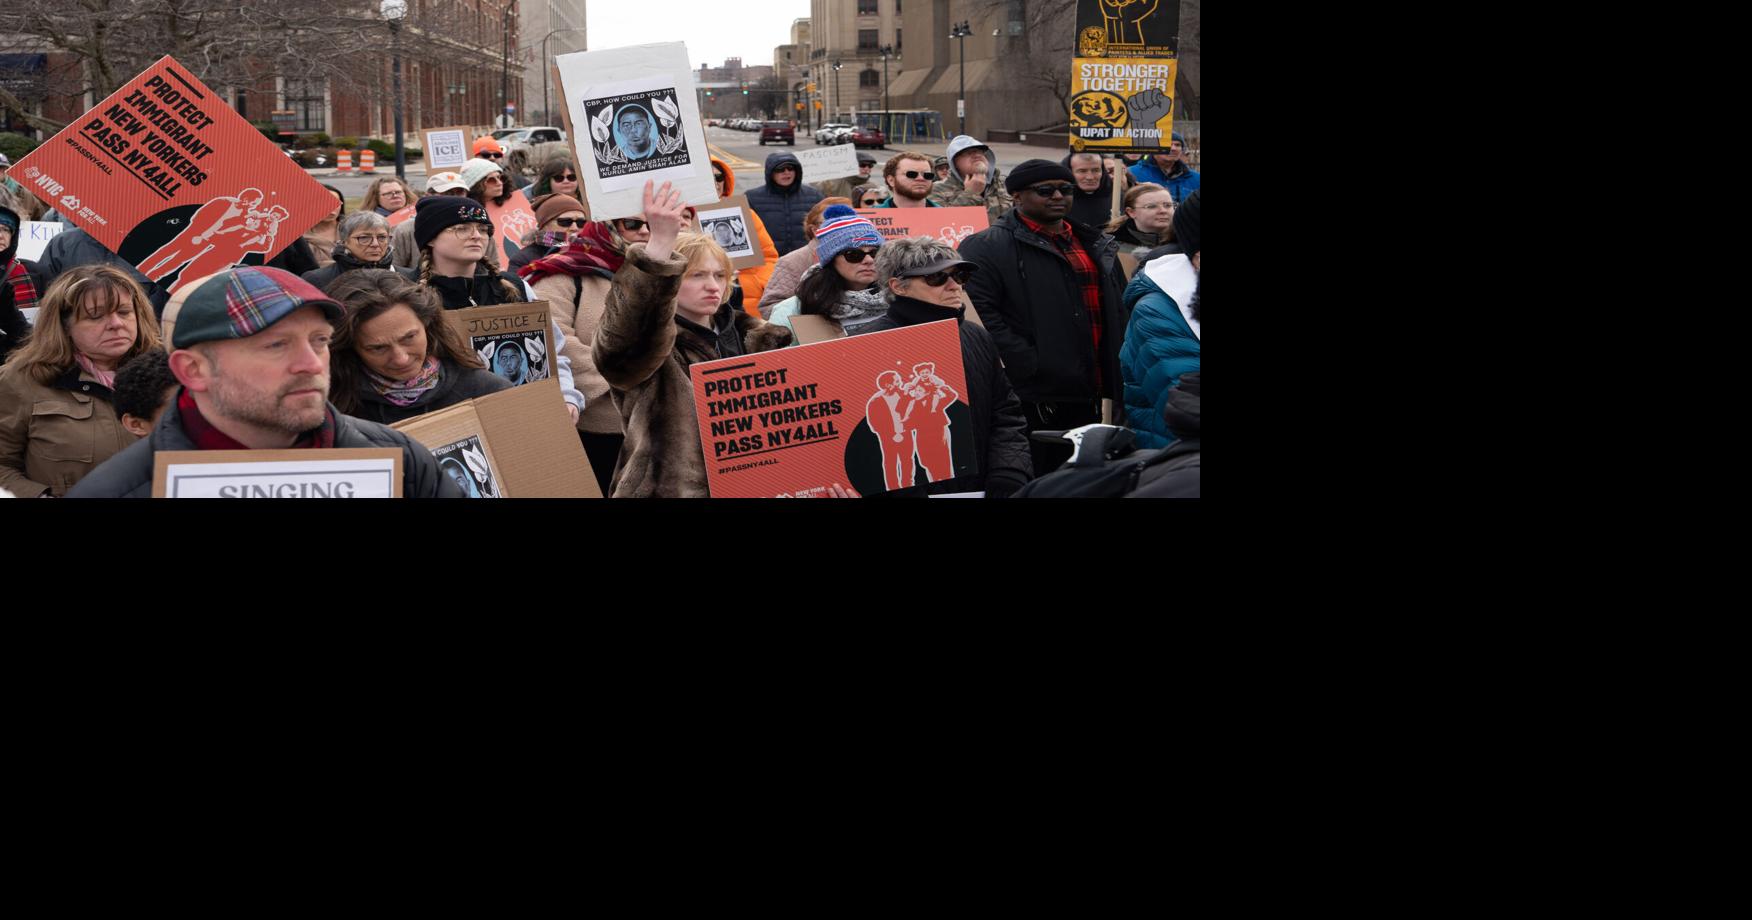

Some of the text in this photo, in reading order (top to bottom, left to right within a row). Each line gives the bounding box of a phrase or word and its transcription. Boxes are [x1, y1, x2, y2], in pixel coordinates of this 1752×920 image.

[1081, 63, 1168, 78] STRONGER
[1080, 78, 1166, 92] TOGETHER
[144, 75, 214, 131] PROTECT
[621, 93, 645, 102] COULD
[124, 89, 214, 160] IMMIGRANT
[1080, 127, 1162, 138] IUPAT IN ACTION
[104, 104, 208, 187] NEW YORKERS
[435, 145, 460, 156] ICE
[66, 138, 113, 176] #PASSNY4ALL
[83, 118, 182, 198] PASS NY4ALL
[612, 161, 642, 171] DEMAND
[644, 156, 672, 166] JUSTICE
[602, 168, 626, 177] NURUL
[648, 161, 667, 169] SHAH
[35, 174, 64, 197] NYIC
[869, 217, 893, 226] TECT
[879, 227, 910, 236] GRANT
[468, 312, 547, 333] JUSTICE 4
[704, 368, 787, 397] PROTECT
[707, 383, 818, 417] IMMIGRANT
[711, 399, 843, 437] NEW YORKERS
[714, 421, 839, 457] PASS NY4ALL
[437, 445, 455, 455] COULD
[718, 458, 780, 475] #PASSNY4ALL
[218, 481, 354, 498] SINGING
